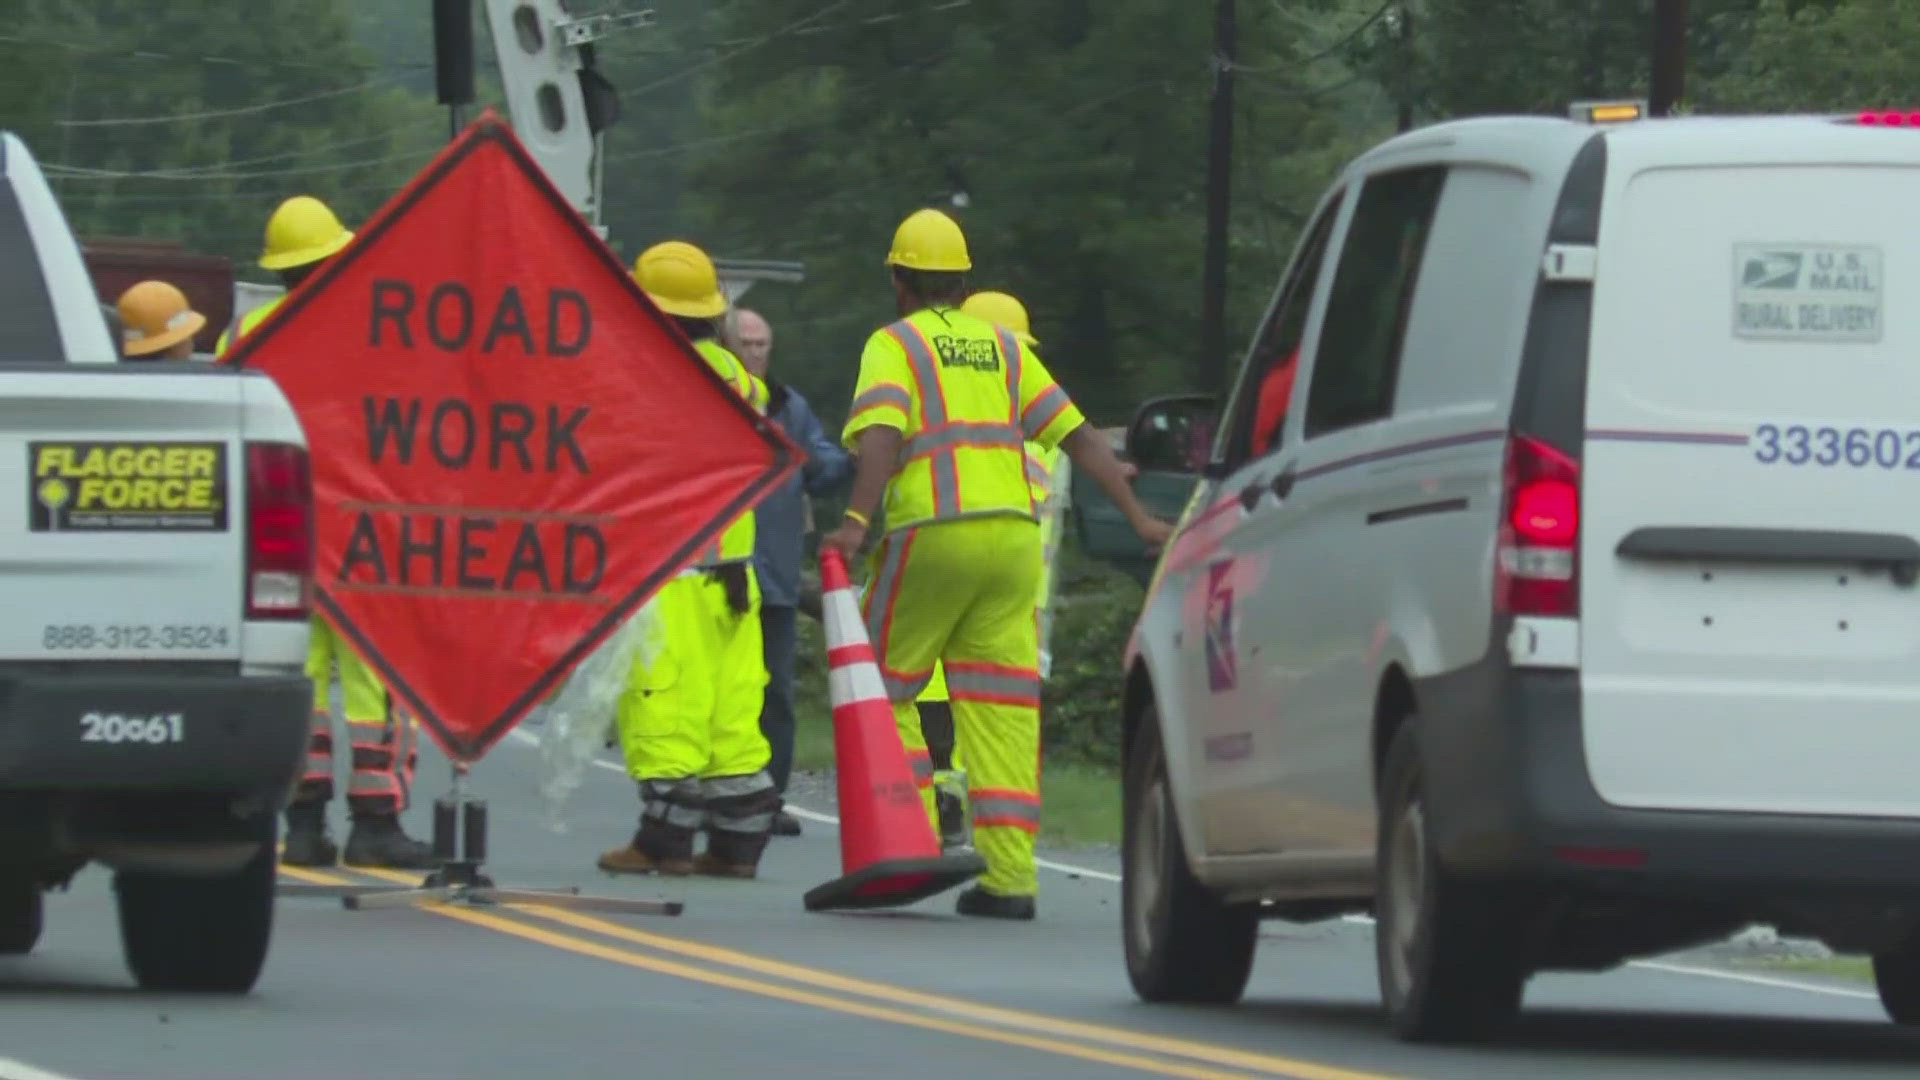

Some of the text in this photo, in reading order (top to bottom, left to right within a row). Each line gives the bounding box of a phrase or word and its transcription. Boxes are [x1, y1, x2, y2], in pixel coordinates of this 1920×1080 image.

[1810, 273, 1876, 292] MAIL
[369, 278, 592, 357] ROAD
[1738, 302, 1879, 332] RURAL DELIVERY
[362, 396, 591, 475] WORK
[36, 446, 217, 477] FLAGGER
[76, 479, 215, 509] FORCE
[338, 511, 608, 595] AHEAD
[42, 624, 230, 650] 888-312-3524
